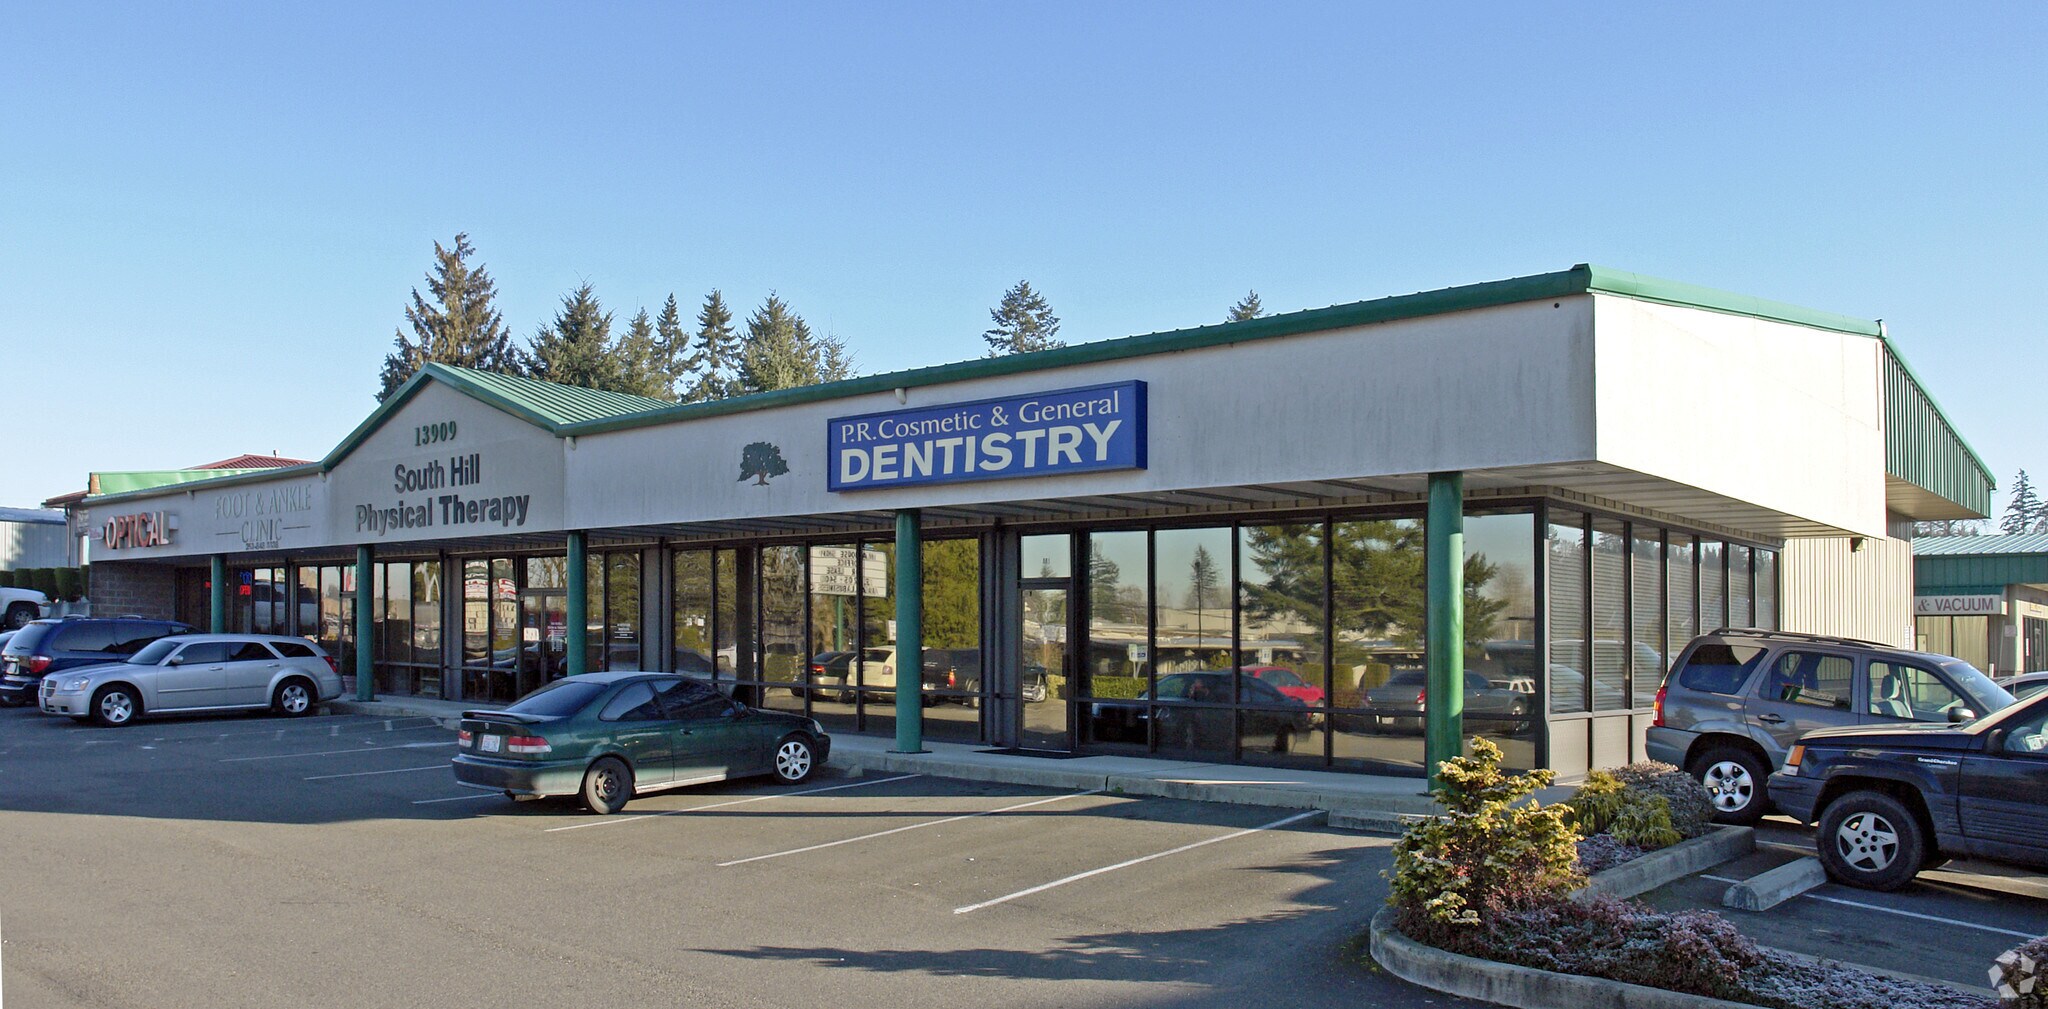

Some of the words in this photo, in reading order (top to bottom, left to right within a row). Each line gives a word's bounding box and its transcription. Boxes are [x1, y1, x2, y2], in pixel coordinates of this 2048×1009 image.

[414, 420, 457, 446] 13909
[878, 411, 982, 438] Cosmetic
[990, 405, 1009, 427] &
[1018, 390, 1120, 424] General
[840, 419, 1122, 484] DENTISTRY
[394, 459, 445, 494] South
[451, 453, 480, 487] Hill
[215, 493, 250, 520] FOOT
[255, 490, 264, 516] &
[269, 484, 311, 514] ANKLE
[355, 497, 433, 536] Physical
[438, 494, 530, 527] Therapy
[105, 511, 169, 550] OPTICAL
[241, 518, 282, 543] CLINIC
[1918, 600, 1930, 612] &
[1934, 598, 1994, 612] VACUUM
